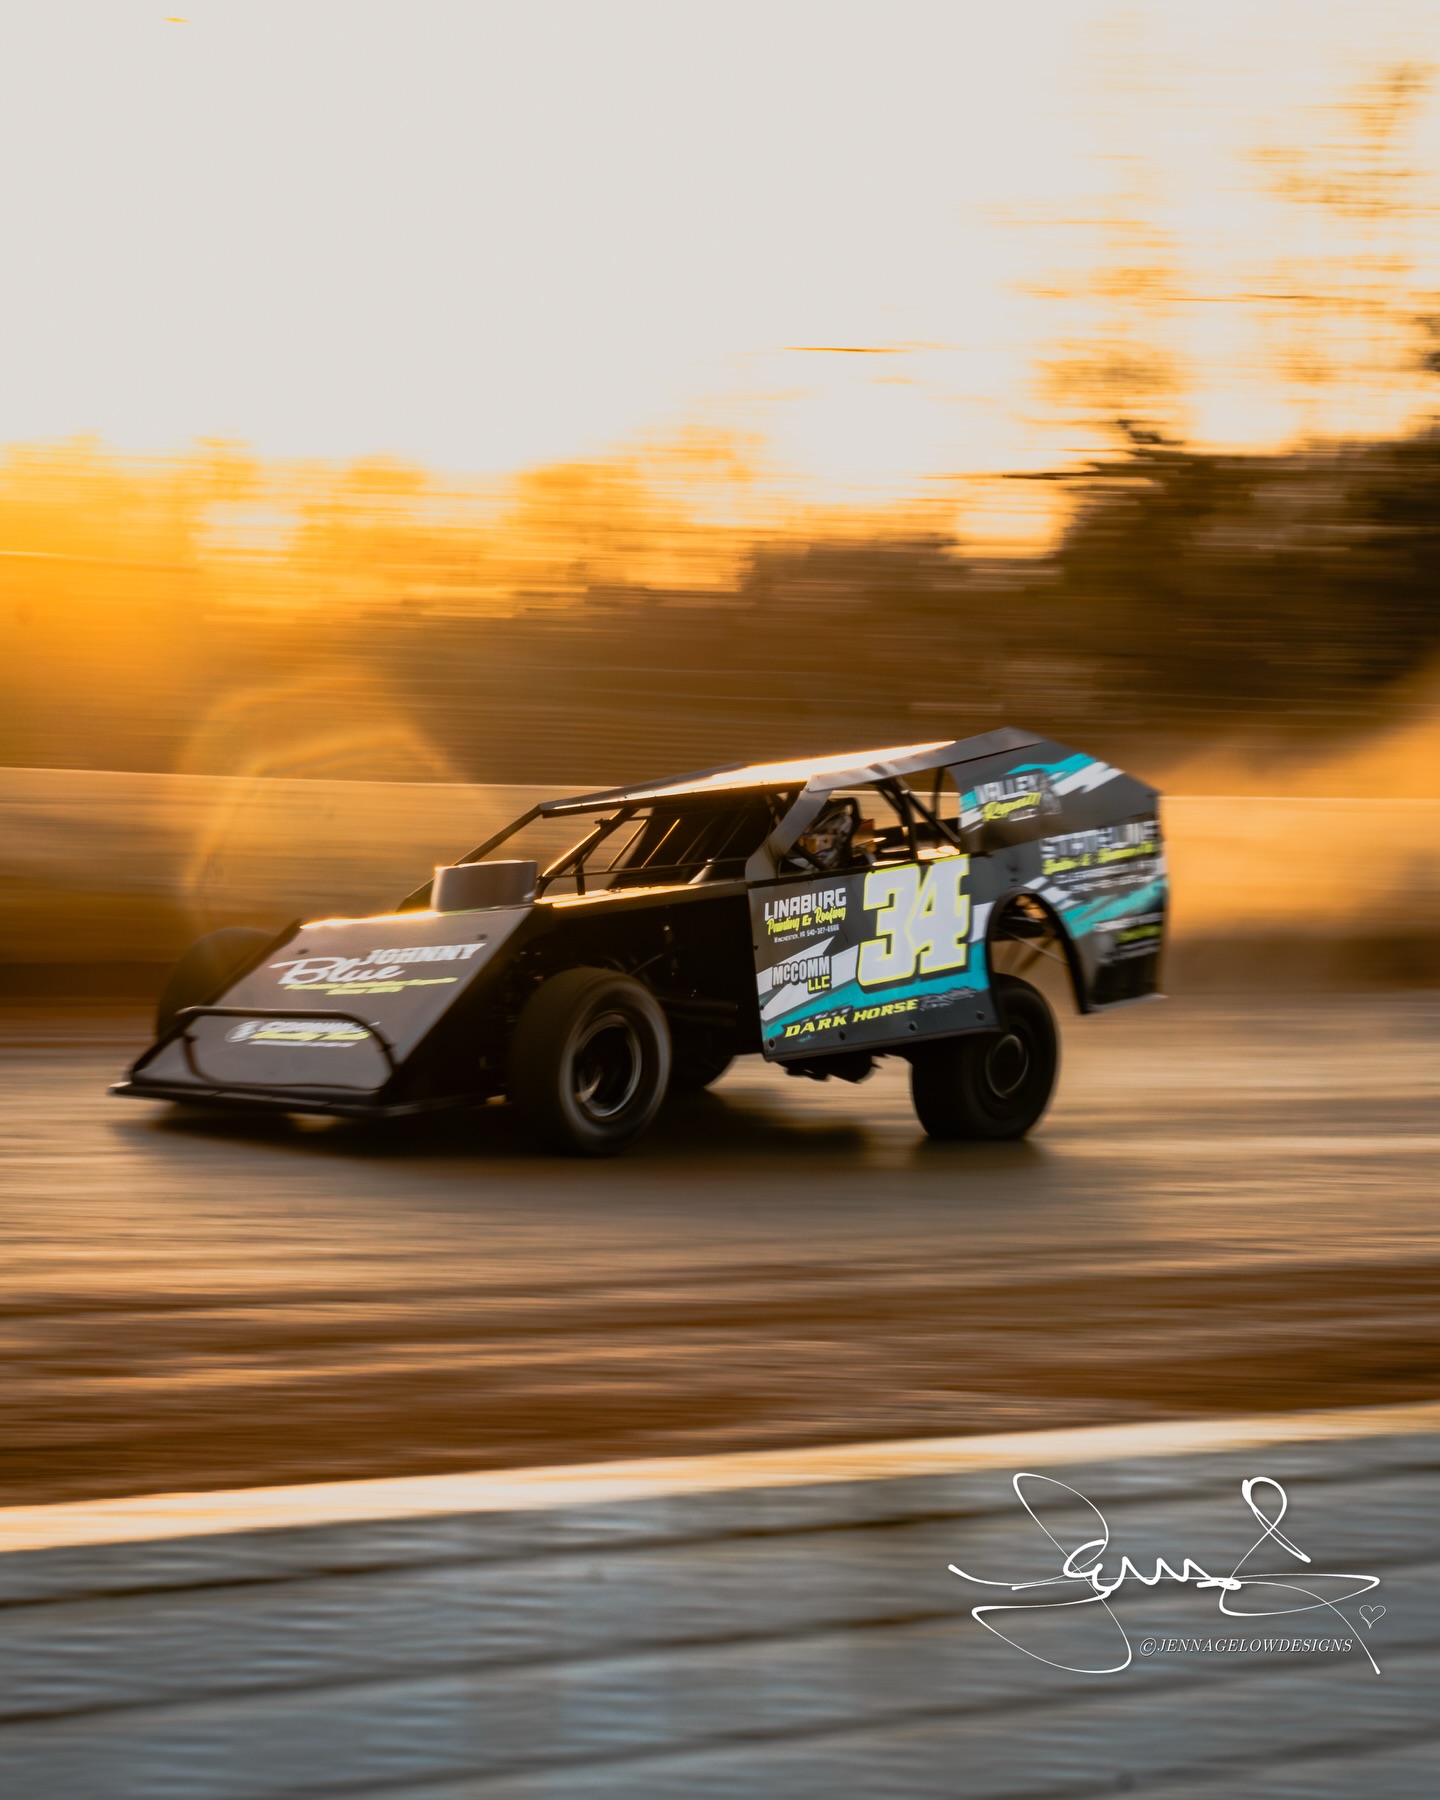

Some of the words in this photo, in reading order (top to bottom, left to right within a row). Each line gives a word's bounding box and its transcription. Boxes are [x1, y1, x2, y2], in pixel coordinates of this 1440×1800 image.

[764, 887, 847, 922] LINABURG
[766, 916, 800, 935] Painting
[814, 906, 846, 924] Roofing
[858, 853, 970, 987] 34
[269, 957, 405, 985] Blue
[808, 975, 831, 993] LLC
[785, 1012, 848, 1038] DARK
[852, 999, 919, 1023] HORSE
